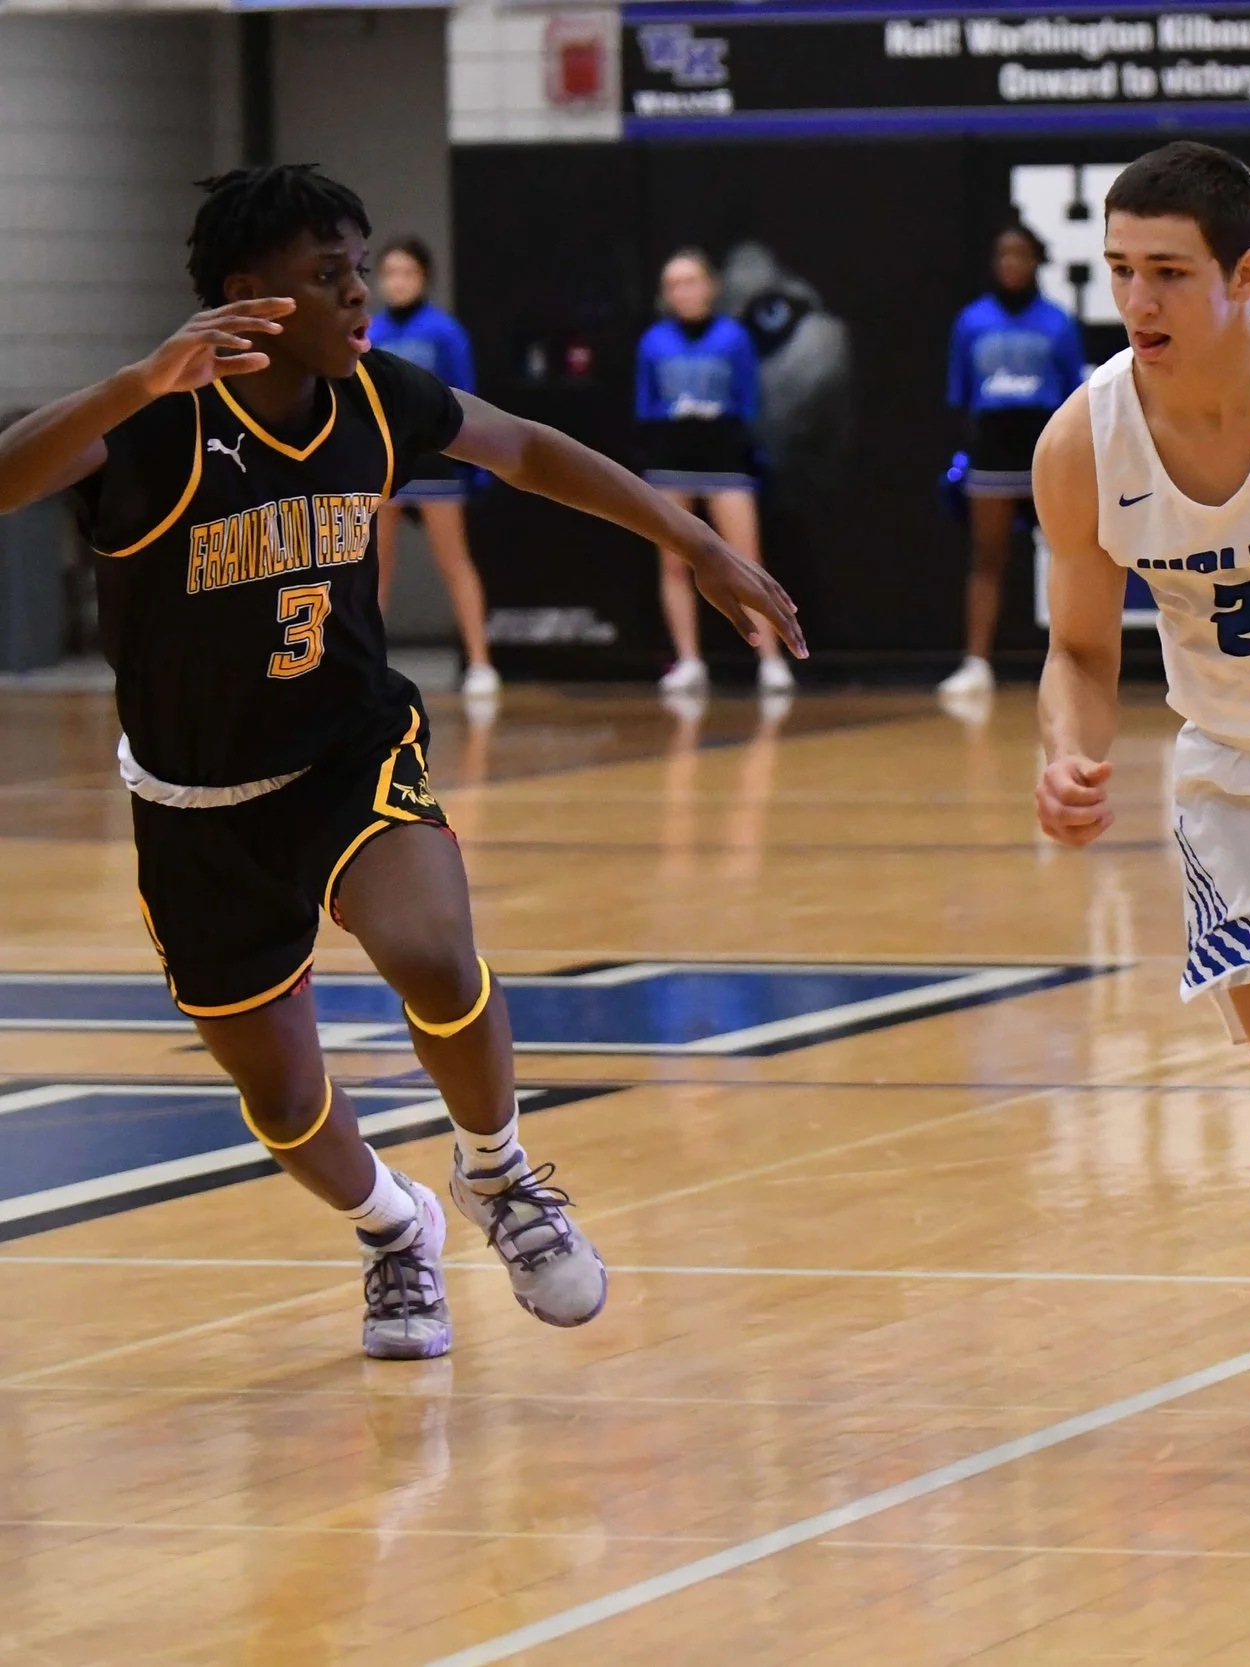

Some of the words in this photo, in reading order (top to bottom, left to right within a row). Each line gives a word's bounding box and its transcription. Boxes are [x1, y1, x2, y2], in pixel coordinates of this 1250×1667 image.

[965, 19, 1154, 58] Worthington
[1000, 62, 1117, 99] Onward
[1122, 63, 1157, 97] to
[187, 496, 311, 594] FRANKLIN
[267, 580, 331, 679] 3
